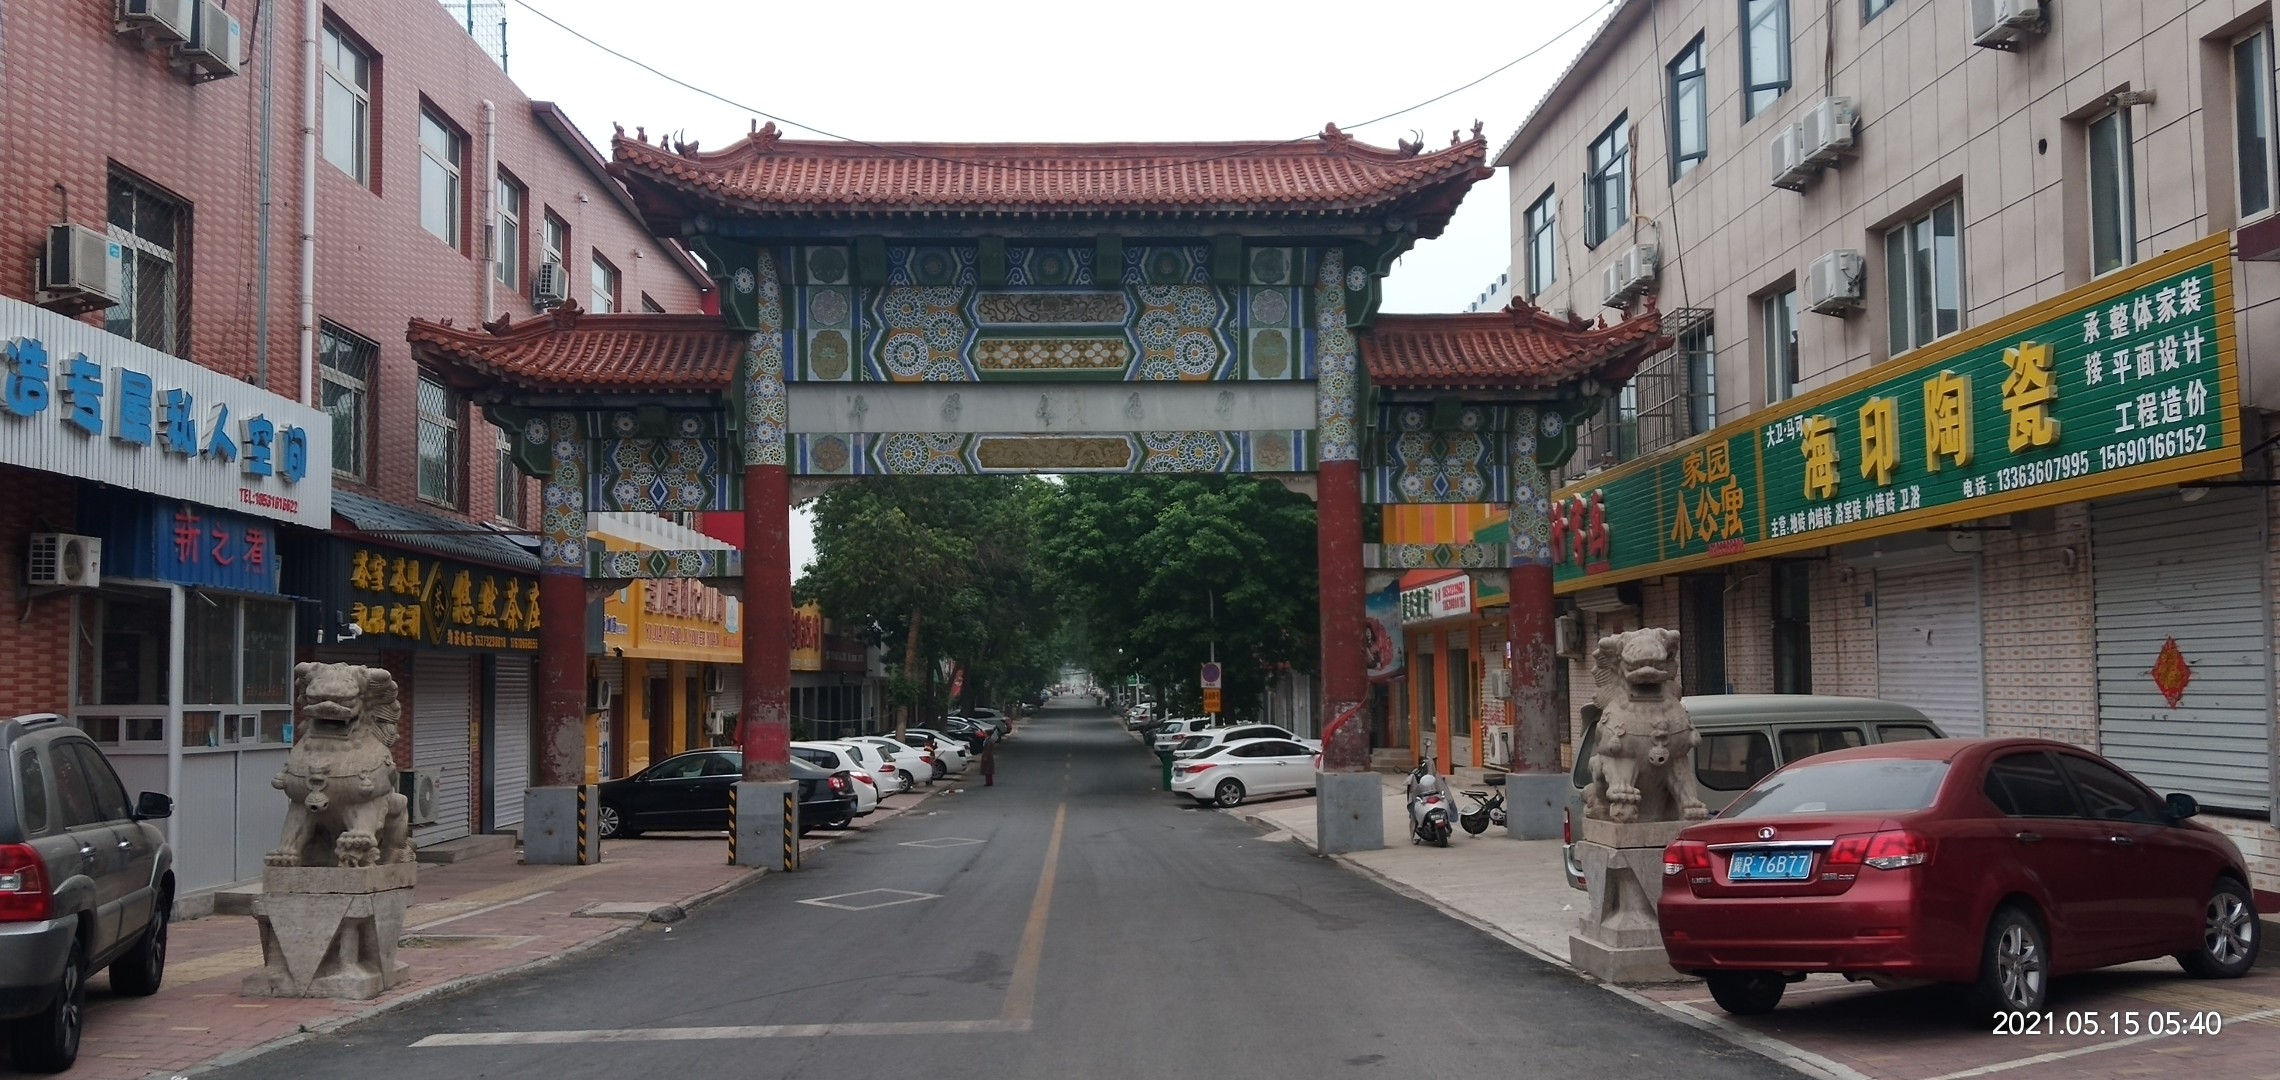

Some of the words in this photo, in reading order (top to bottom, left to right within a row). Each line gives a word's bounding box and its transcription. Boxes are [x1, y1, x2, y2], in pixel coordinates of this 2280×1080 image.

[2109, 276, 2202, 341] 整体家装
[2112, 326, 2205, 385] 平面设计
[1800, 341, 2061, 501] 海印陶瓷
[2115, 378, 2208, 434] 工程造价
[1681, 440, 1730, 490] 家园
[2100, 424, 2207, 471] 15690166152
[1671, 474, 1744, 549] 小公寓
[1808, 504, 1832, 530] 内墙砖
[1866, 489, 1895, 518] 外墙砖
[1900, 484, 1921, 511] 卫浴
[351, 550, 386, 592] 茶室
[389, 557, 421, 598] 茶具
